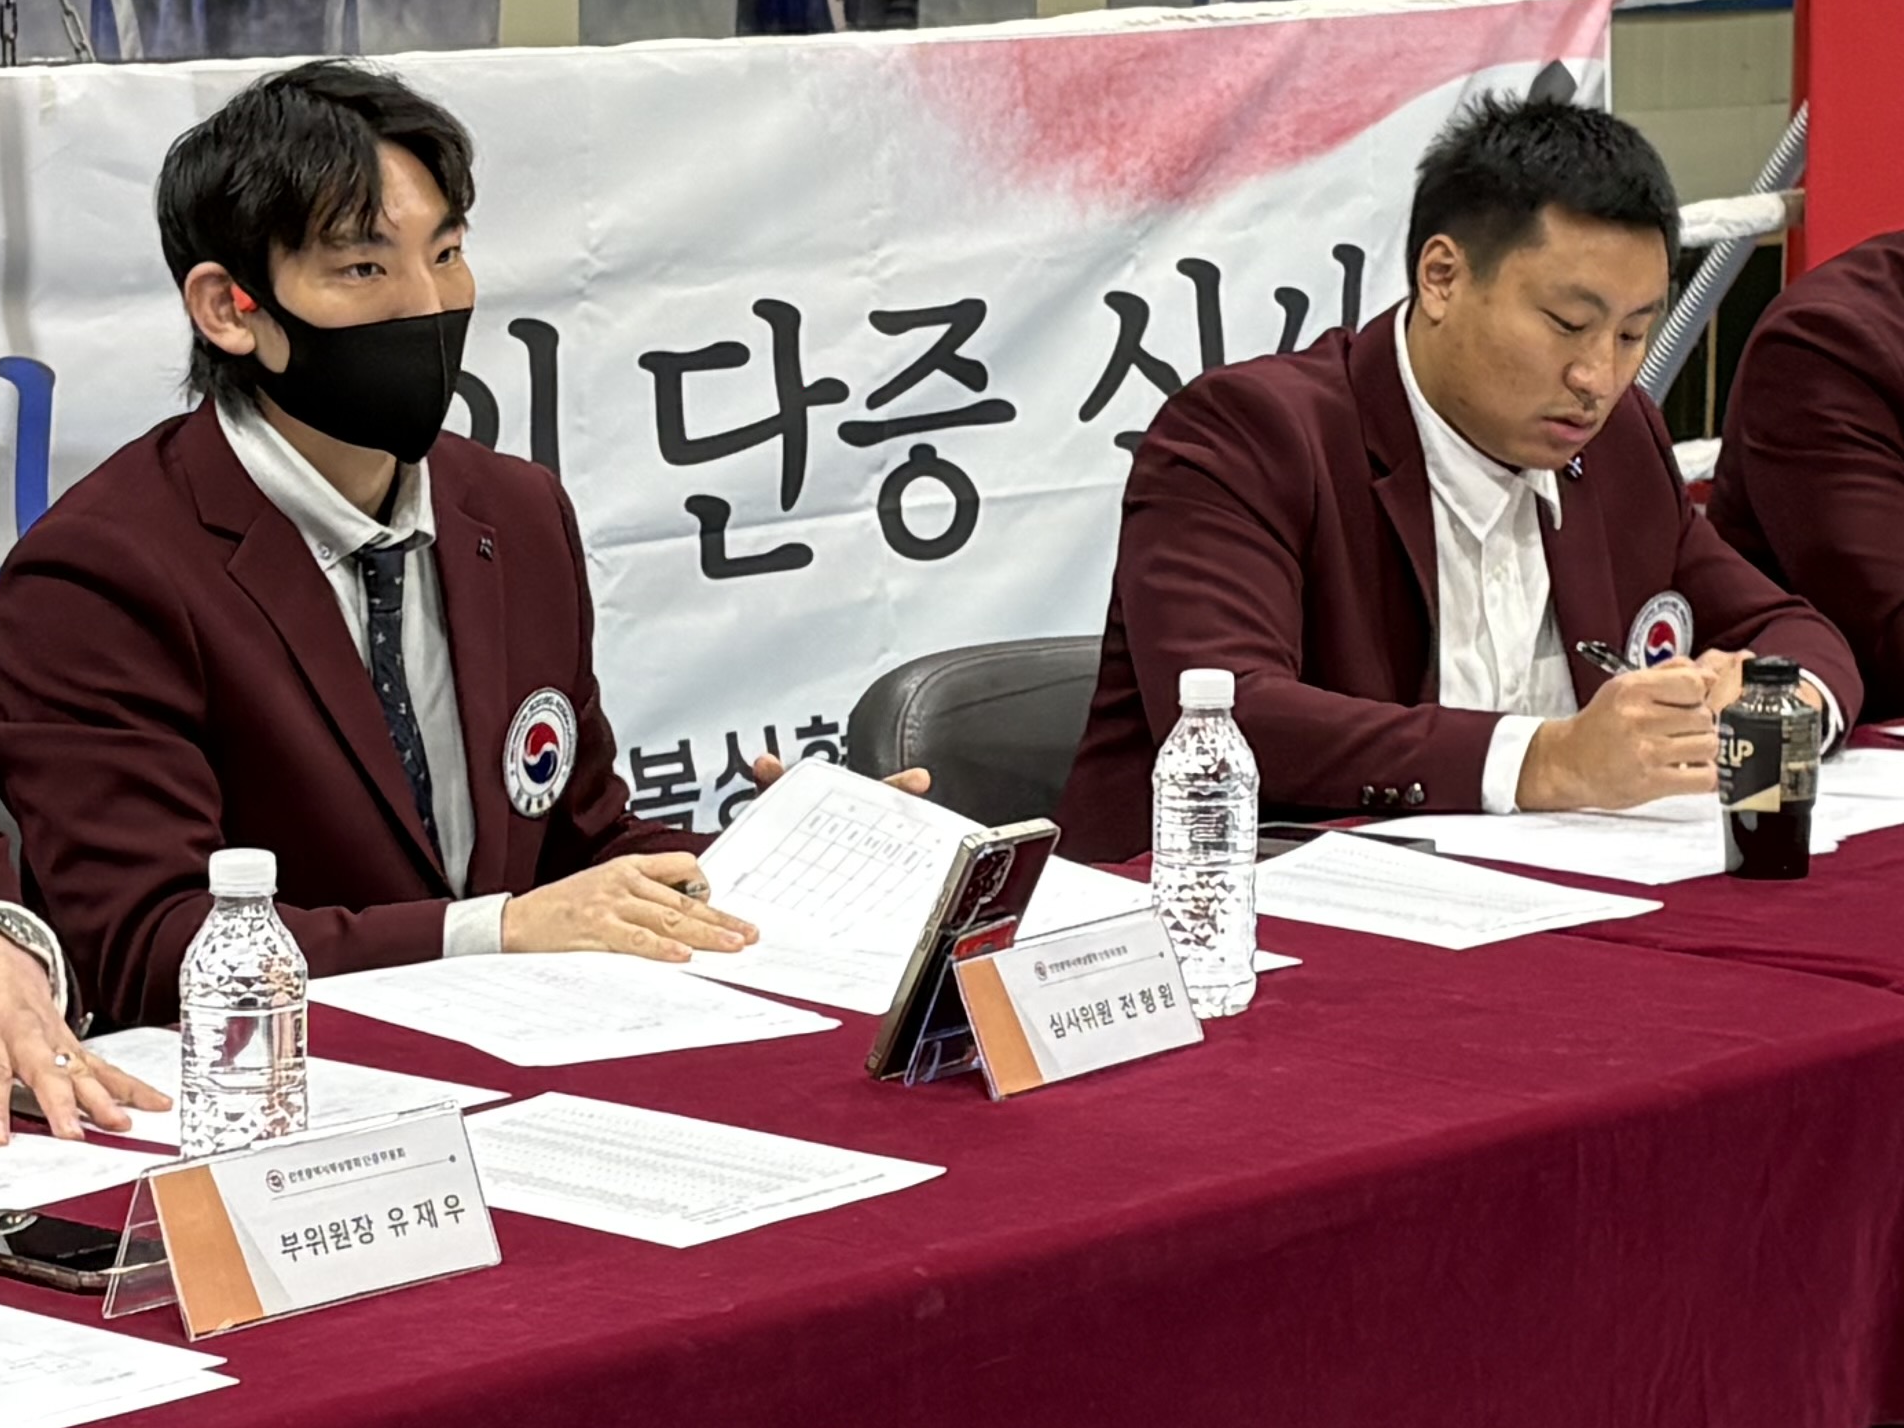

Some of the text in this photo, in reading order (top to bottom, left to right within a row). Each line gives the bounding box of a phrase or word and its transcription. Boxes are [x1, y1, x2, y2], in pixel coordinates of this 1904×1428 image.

[637, 297, 1018, 581] 단증
[1048, 999, 1115, 1040] 심사위원
[279, 1213, 375, 1263] 부위원장
